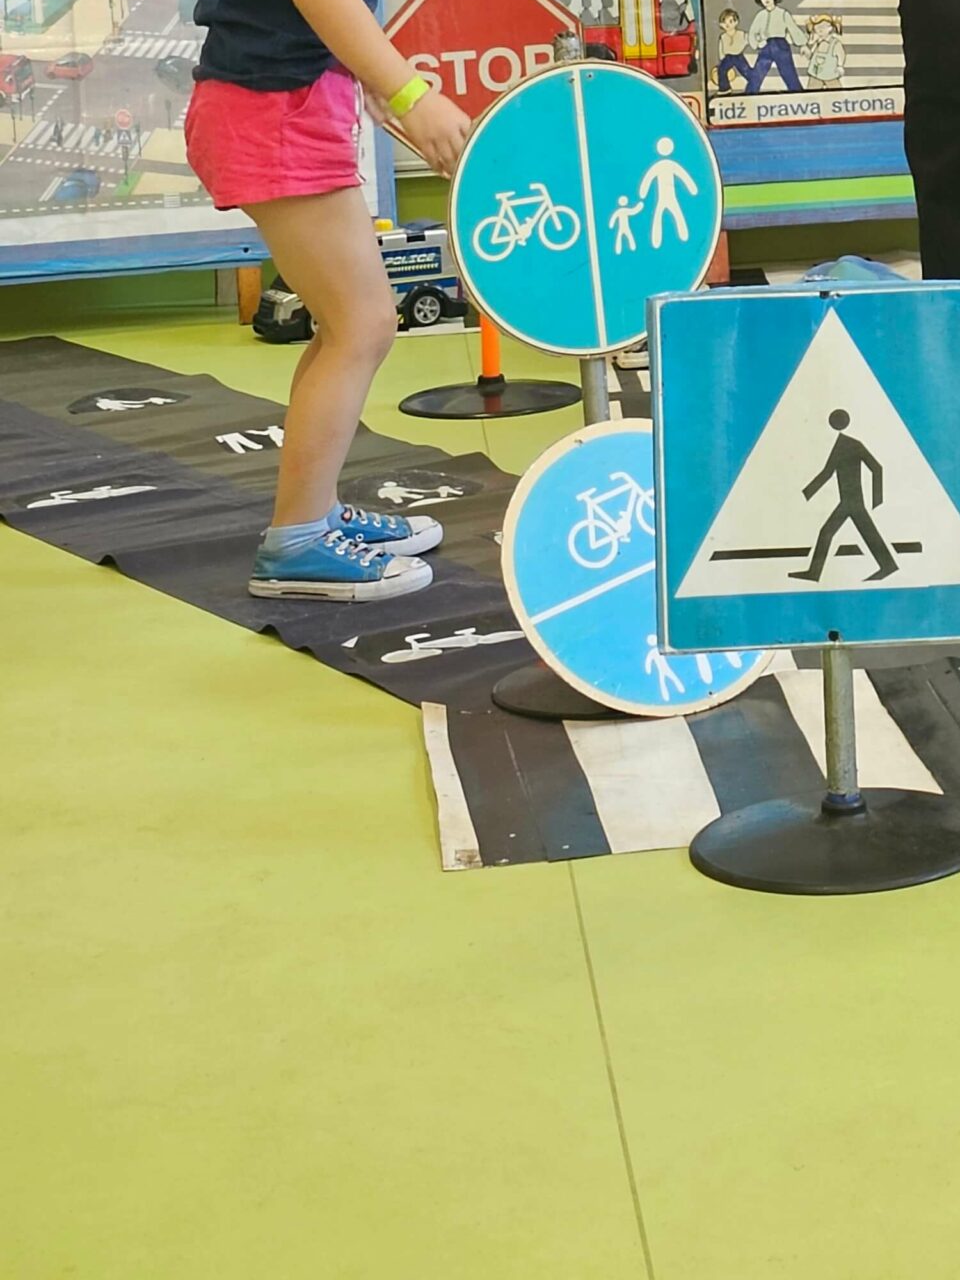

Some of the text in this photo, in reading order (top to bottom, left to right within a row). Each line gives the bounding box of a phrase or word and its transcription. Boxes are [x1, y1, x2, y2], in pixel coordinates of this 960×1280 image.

[719, 98, 896, 121] idź prawą stroną
